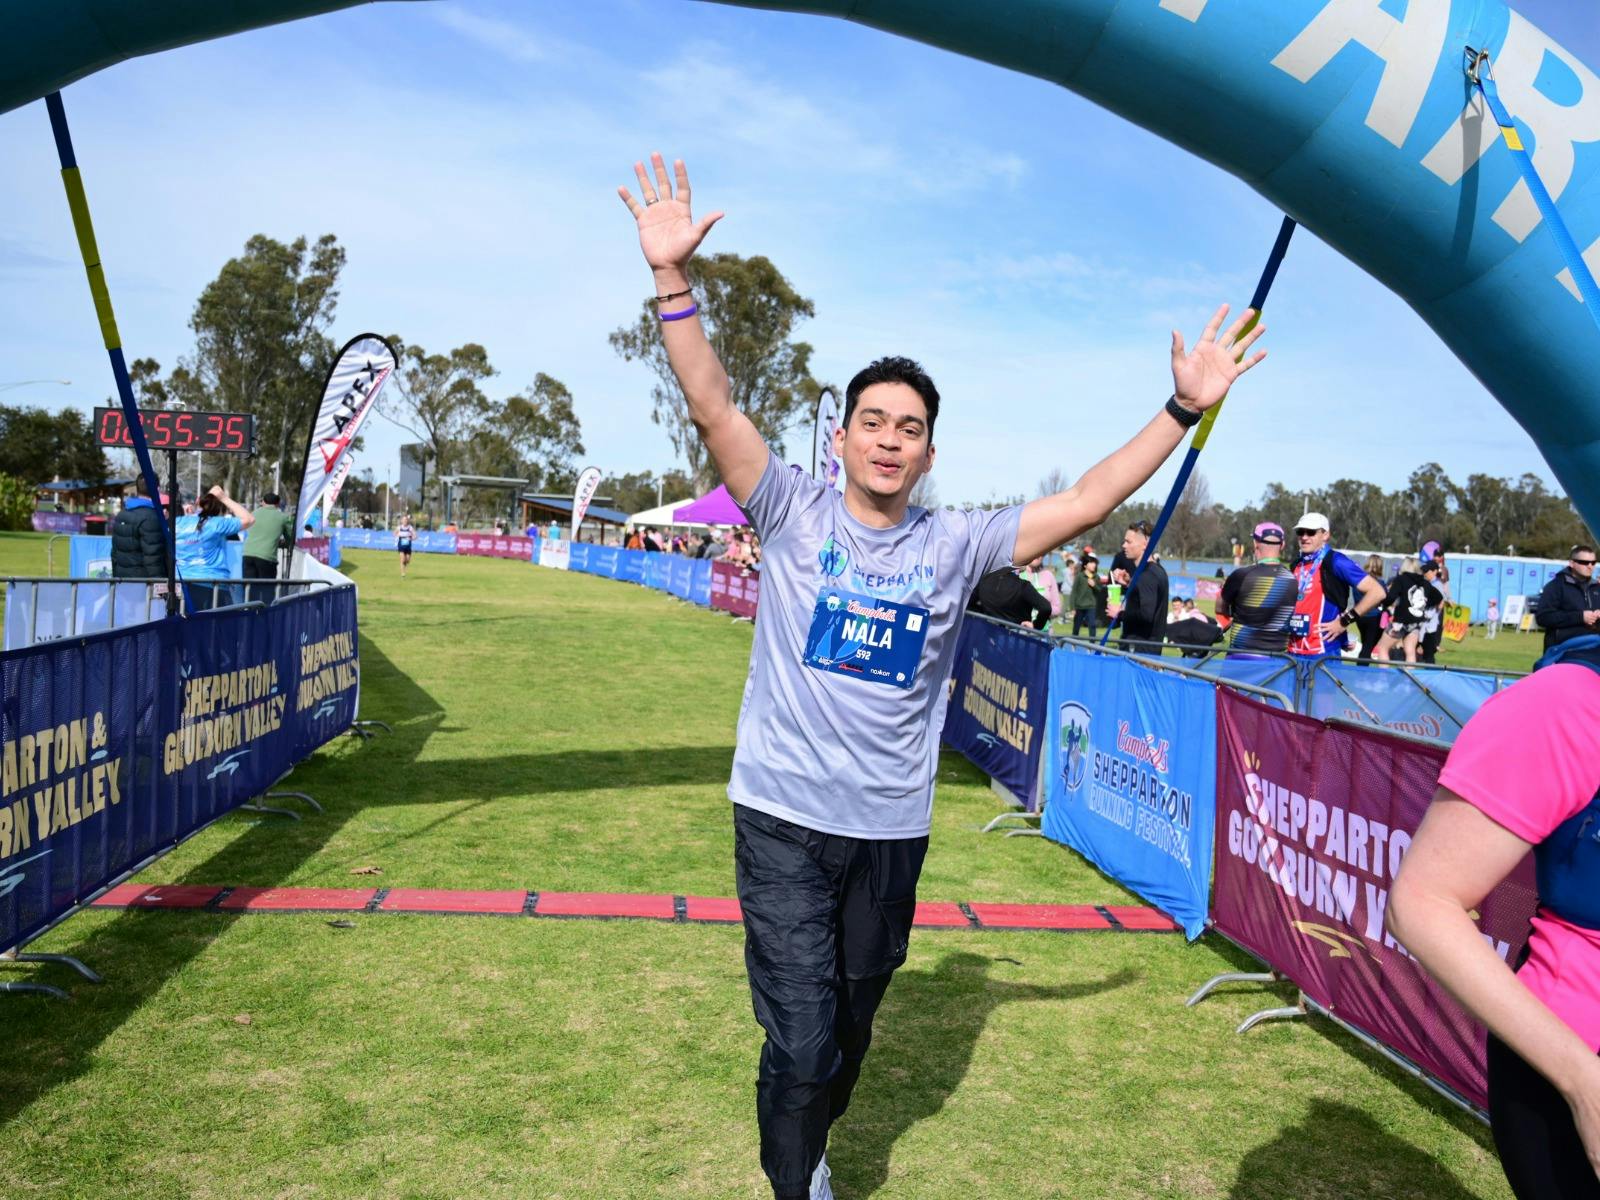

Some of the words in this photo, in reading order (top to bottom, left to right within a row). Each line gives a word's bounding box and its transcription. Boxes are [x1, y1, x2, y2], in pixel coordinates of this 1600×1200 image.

[332, 359, 382, 434] APEX
[841, 618, 893, 650] NALA
[855, 649, 872, 661] 592
[184, 662, 272, 719] SHEPPARTON
[972, 660, 1020, 713] SHEPPARTON
[1018, 686, 1028, 711] &
[244, 693, 287, 742] VALLEY
[0, 717, 88, 797] ARTON
[91, 711, 107, 749] &
[34, 757, 121, 841] VALLEY
[1088, 783, 1134, 831] RUNNING
[1093, 751, 1192, 831] SHEPPARTON
